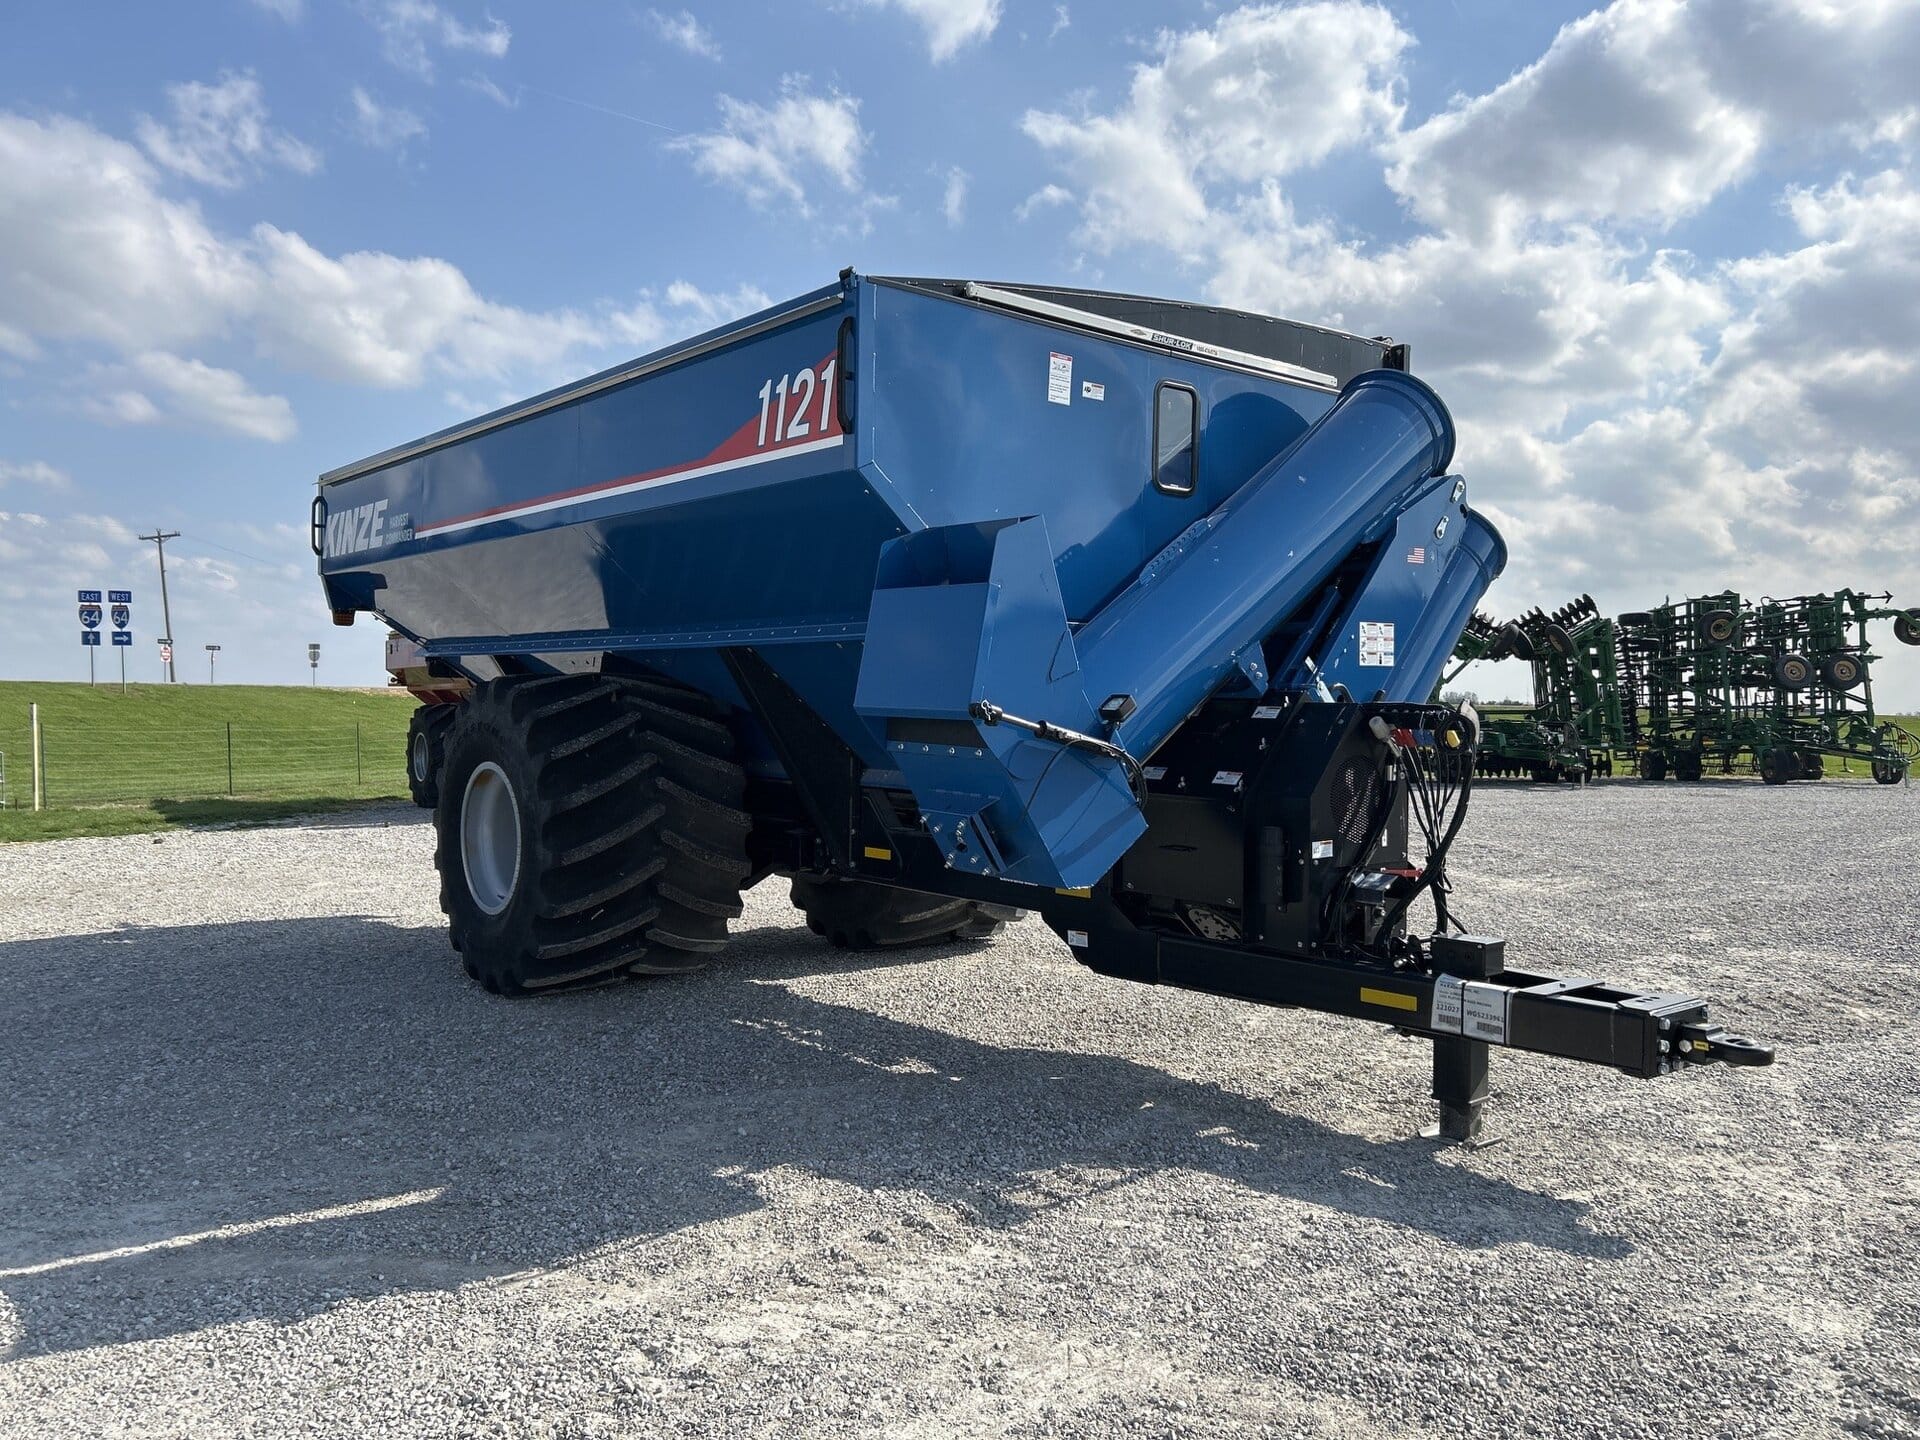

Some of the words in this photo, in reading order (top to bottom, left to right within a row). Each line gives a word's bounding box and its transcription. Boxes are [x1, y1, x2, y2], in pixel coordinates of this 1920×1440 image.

[758, 359, 836, 446] 1121
[322, 498, 389, 559] KINZE
[81, 592, 99, 601] EAST
[111, 592, 130, 601] WEST
[81, 610, 100, 625] 64
[113, 611, 128, 625] 64
